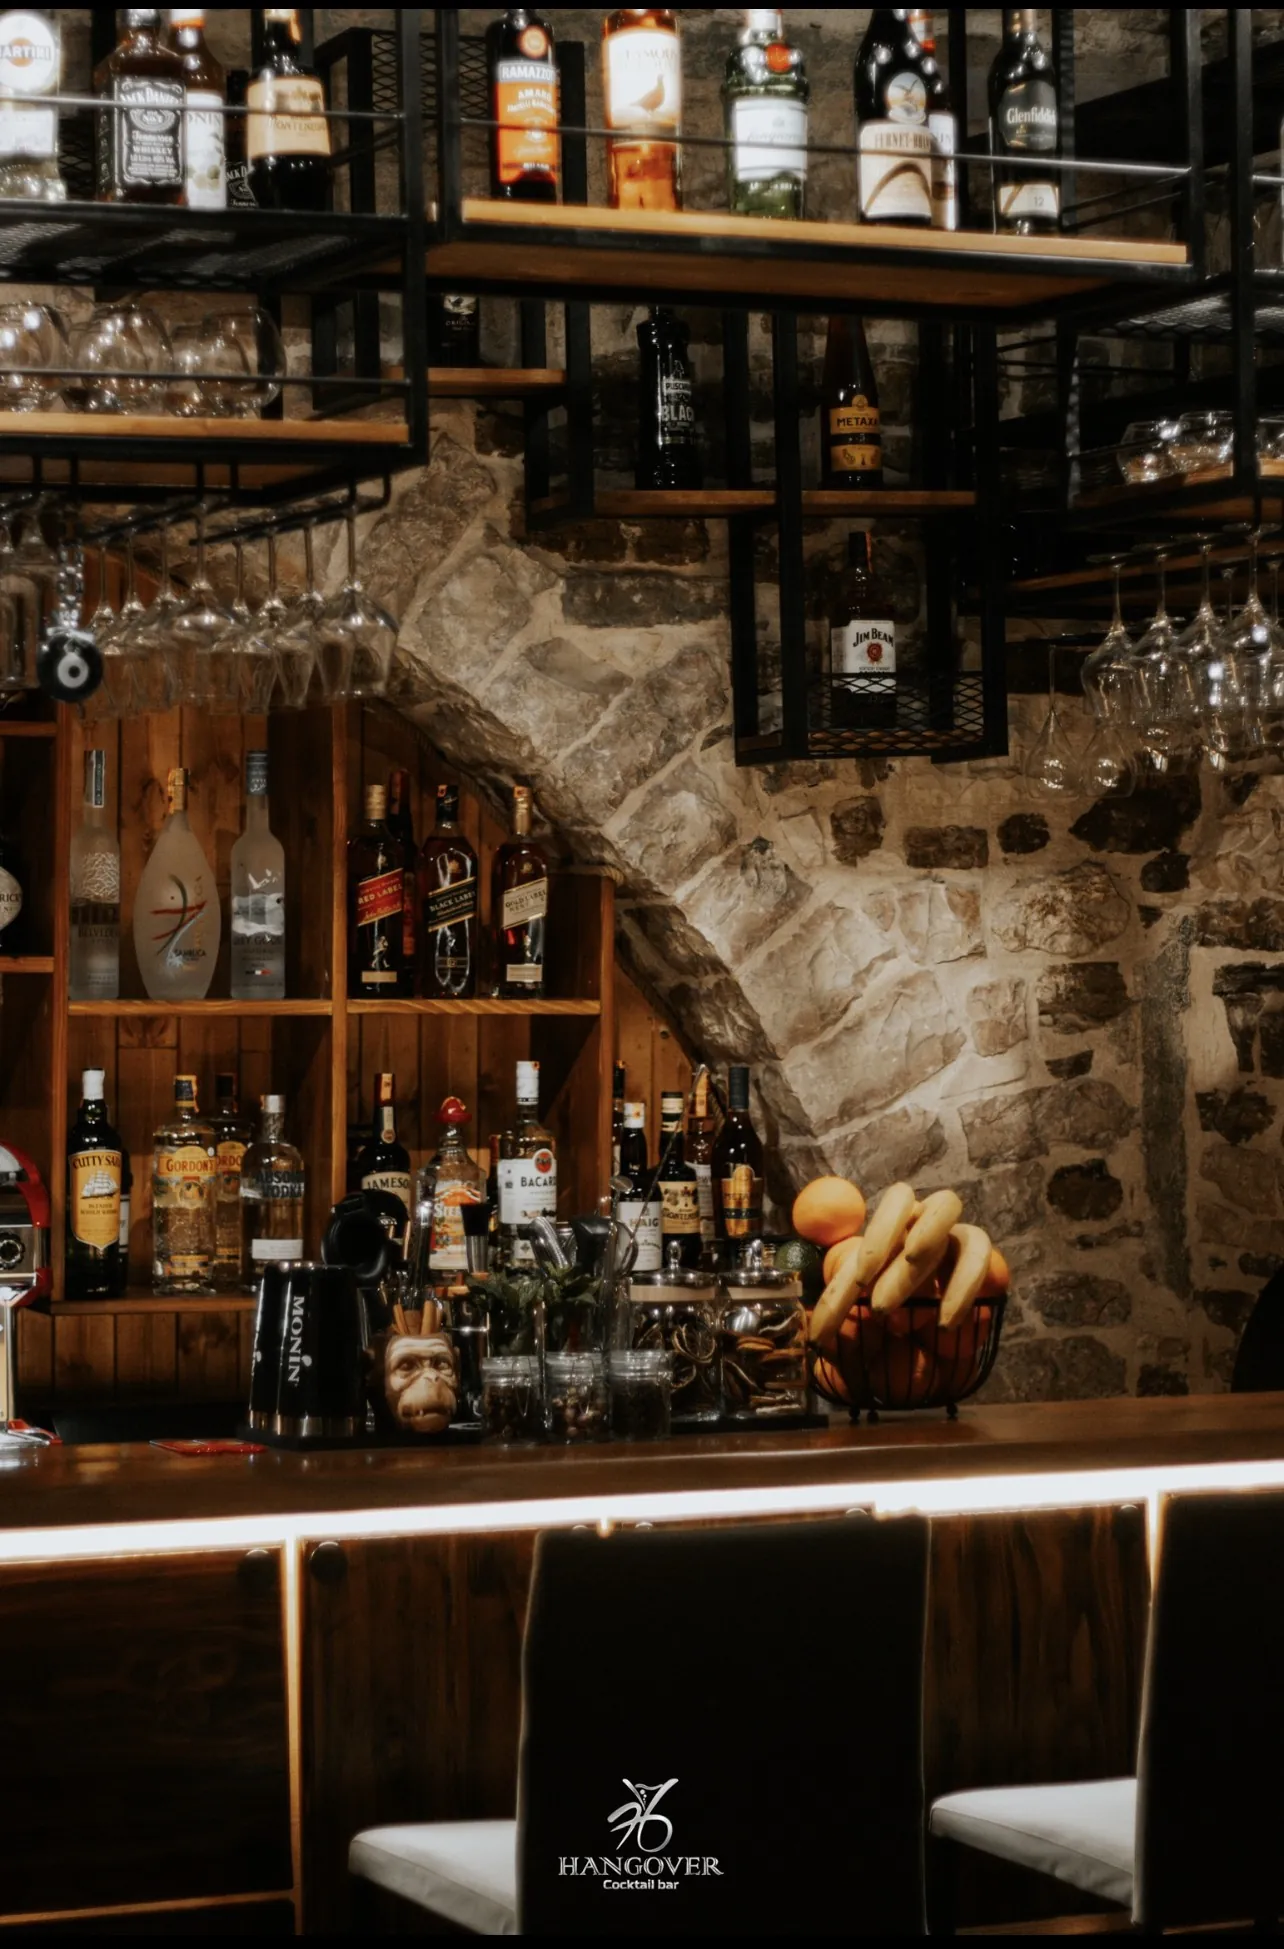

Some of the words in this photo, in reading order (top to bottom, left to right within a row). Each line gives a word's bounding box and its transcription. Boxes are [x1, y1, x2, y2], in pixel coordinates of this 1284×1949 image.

[852, 631, 870, 648] JIM
[358, 893, 376, 905] RED
[376, 883, 403, 898] LABEL
[430, 899, 454, 912] BLACK
[72, 1155, 104, 1170] CUTTY
[630, 1218, 659, 1228] HAIG
[287, 1295, 305, 1382] MONIN
